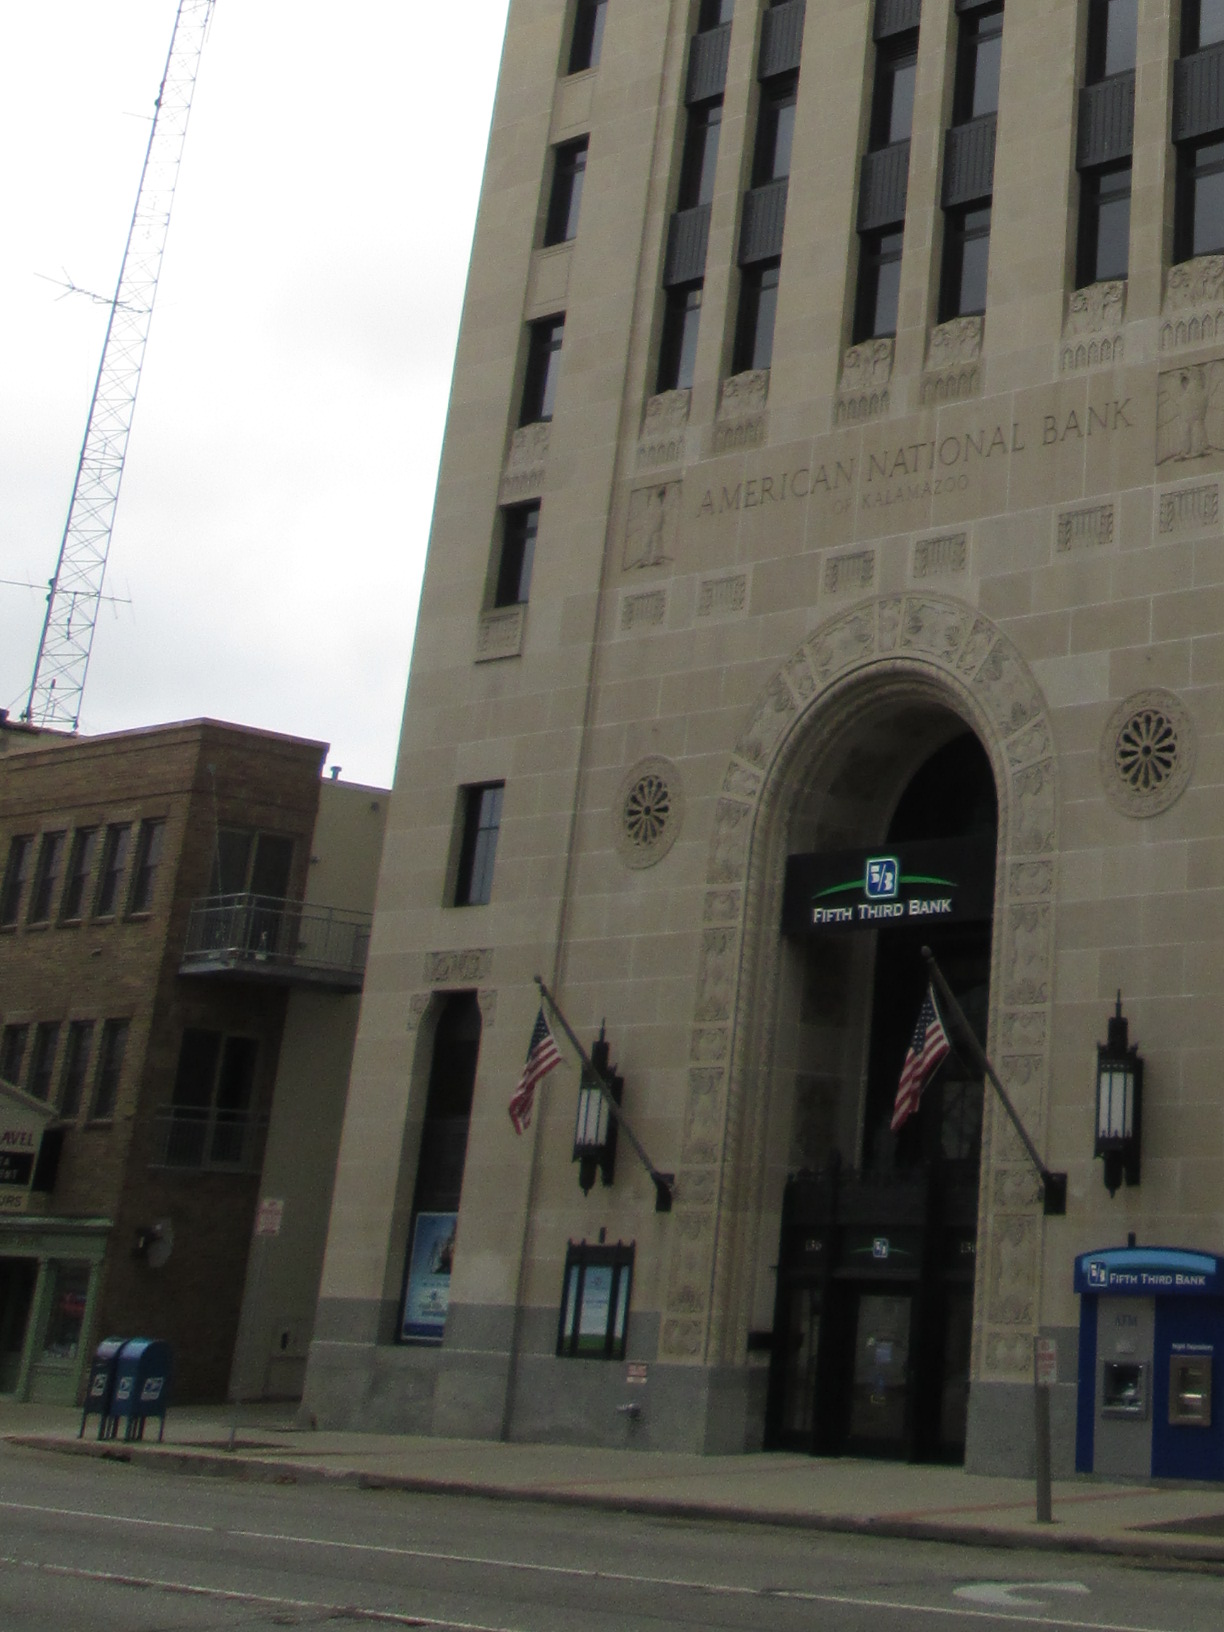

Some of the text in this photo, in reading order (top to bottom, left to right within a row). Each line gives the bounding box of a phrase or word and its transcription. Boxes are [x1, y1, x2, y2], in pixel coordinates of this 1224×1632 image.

[698, 396, 1134, 518] AMERICAN NATIONAL BANK
[832, 473, 970, 516] OF KALAMAZOO
